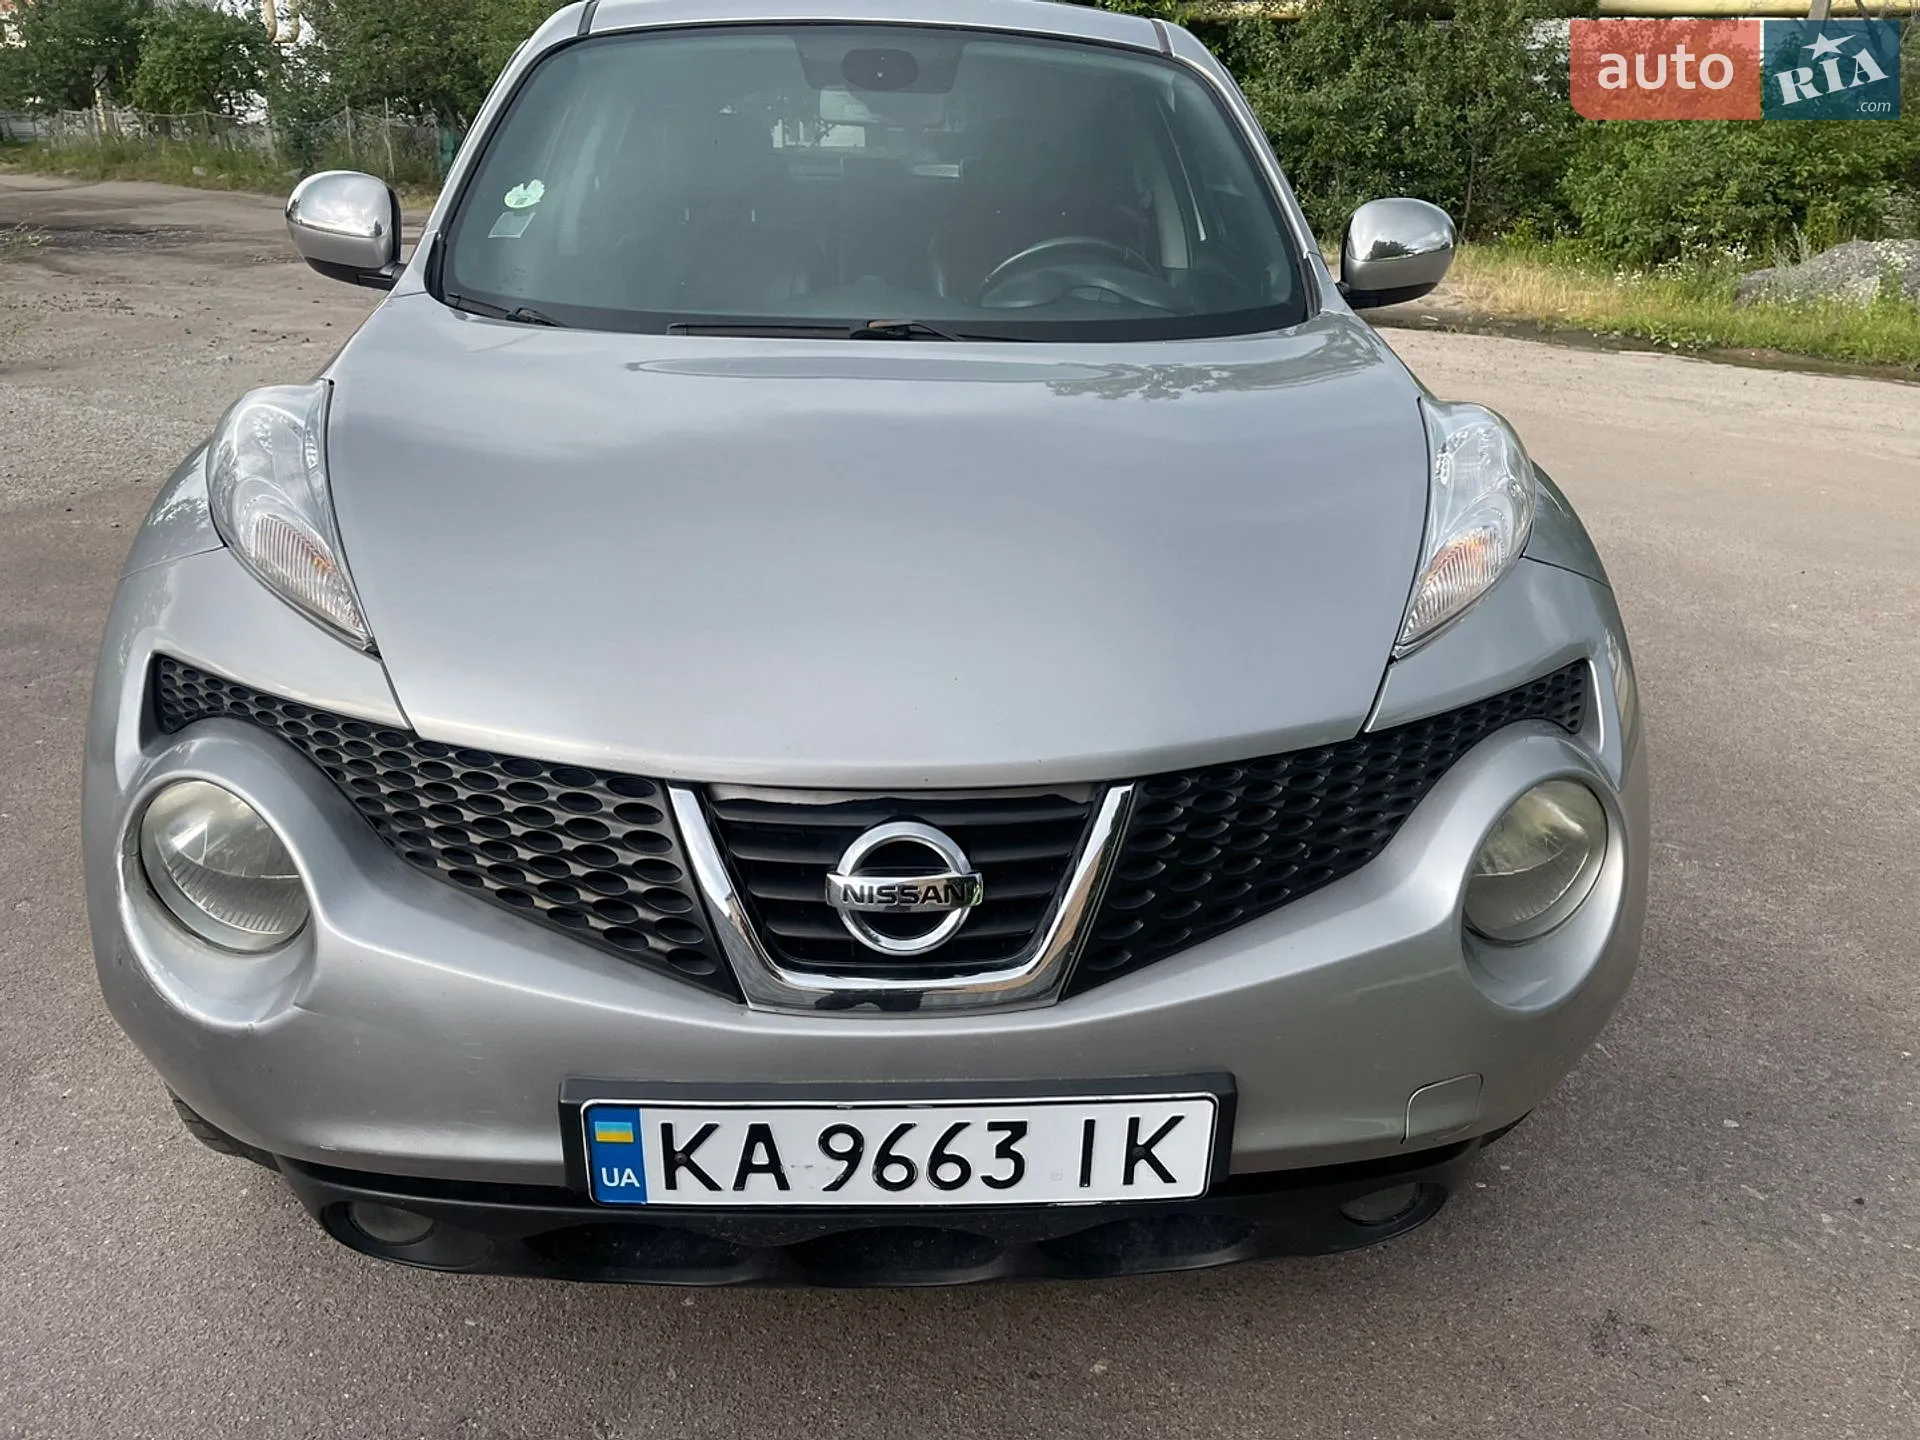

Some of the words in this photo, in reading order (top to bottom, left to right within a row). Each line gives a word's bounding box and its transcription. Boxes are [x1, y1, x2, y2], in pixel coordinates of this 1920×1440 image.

[842, 884, 966, 904] NISSAN
[660, 1122, 791, 1192] KA
[818, 1120, 1028, 1192] 9663
[1079, 1114, 1186, 1189] IK
[601, 1168, 640, 1188] UA
